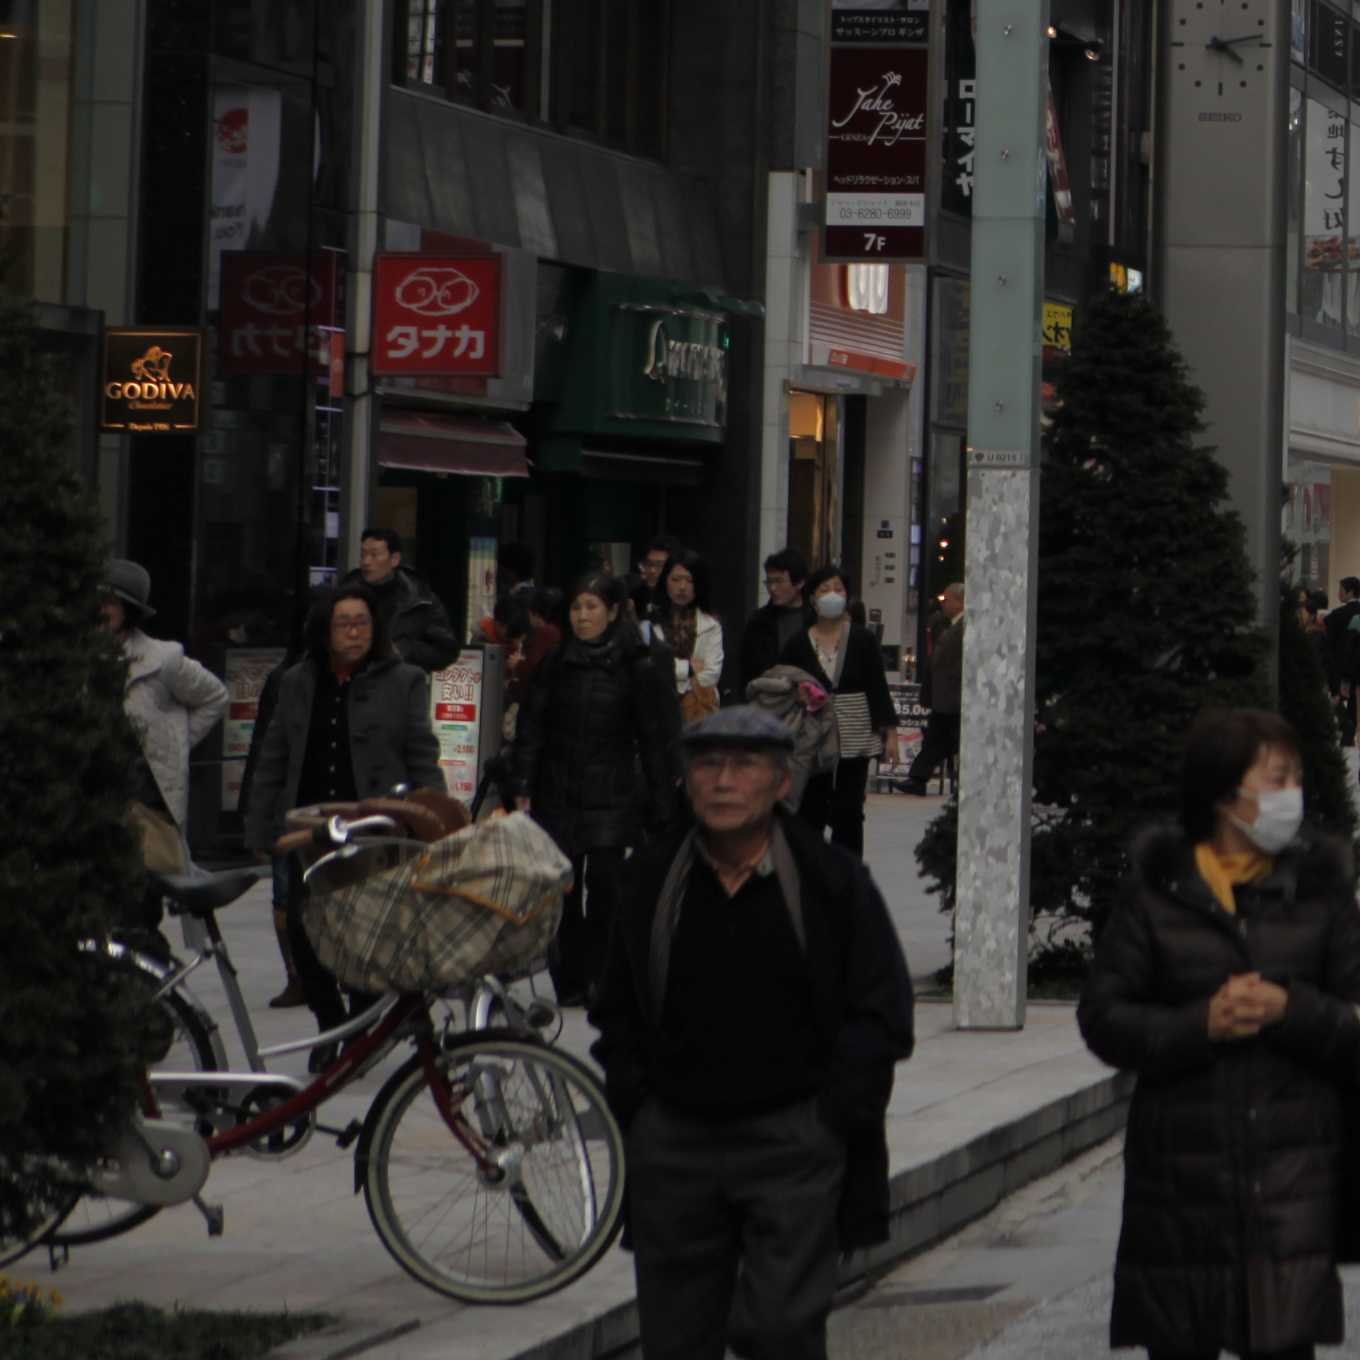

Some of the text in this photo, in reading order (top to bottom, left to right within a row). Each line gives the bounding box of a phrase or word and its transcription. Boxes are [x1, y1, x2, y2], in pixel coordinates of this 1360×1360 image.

[864, 232, 887, 251] 7F
[385, 325, 486, 359] タナカ
[105, 381, 196, 400] GODIVA
